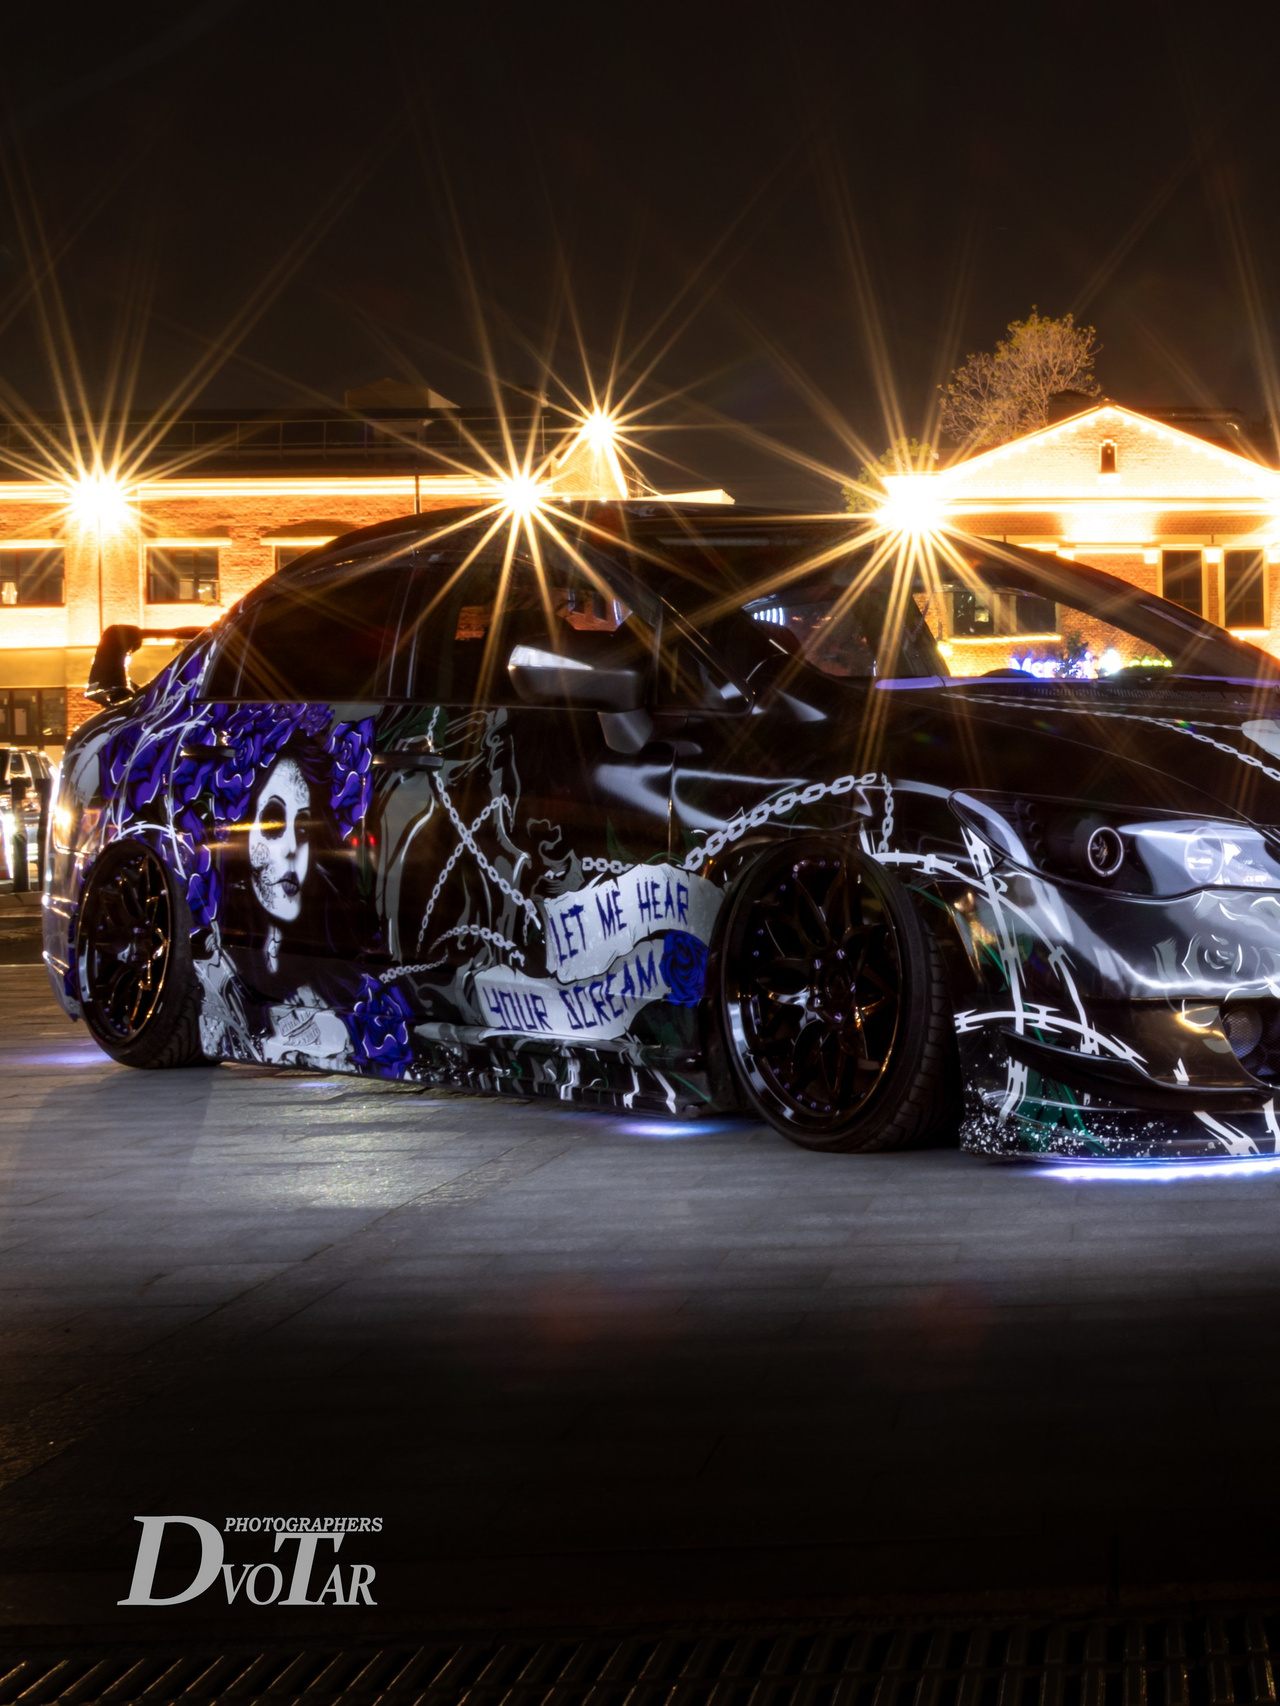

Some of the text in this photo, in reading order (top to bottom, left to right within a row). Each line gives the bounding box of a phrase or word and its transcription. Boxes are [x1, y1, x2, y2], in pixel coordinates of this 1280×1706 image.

[550, 878, 689, 966] LET ME HEAR
[482, 950, 658, 1031] YOUR SCREAM
